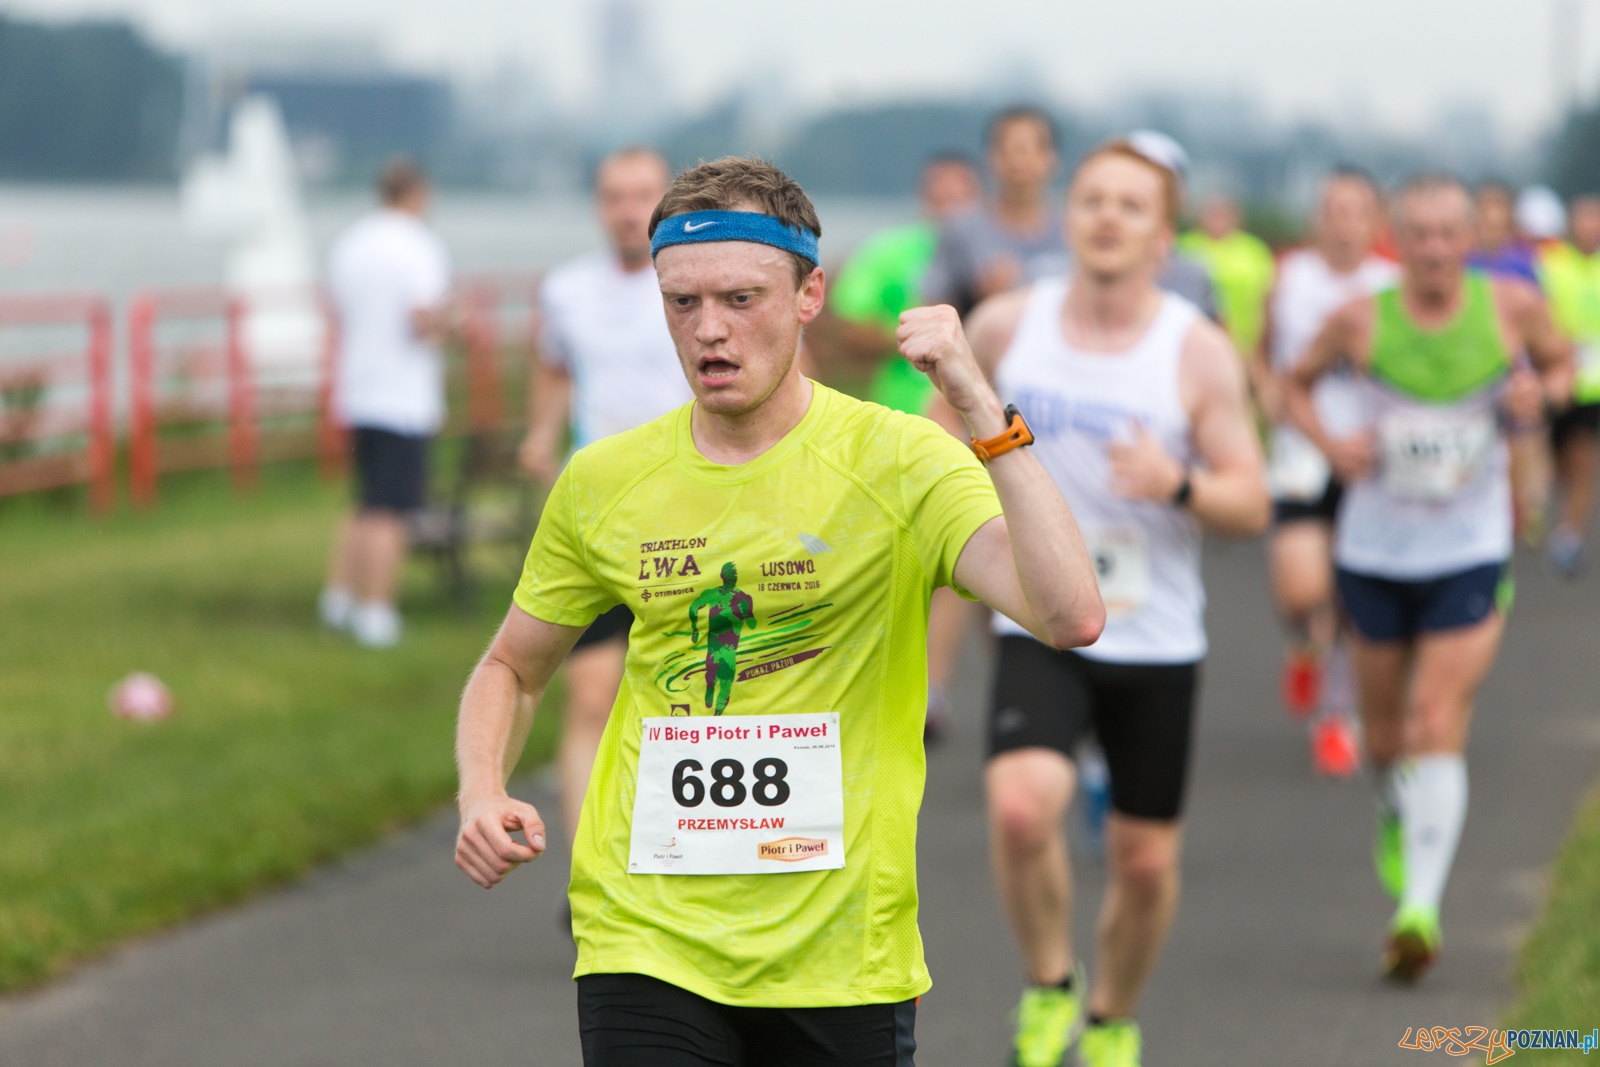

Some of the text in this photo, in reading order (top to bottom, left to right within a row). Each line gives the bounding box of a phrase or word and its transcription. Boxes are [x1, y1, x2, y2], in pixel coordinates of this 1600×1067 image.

[640, 538, 707, 553] TRIATHLON
[638, 554, 701, 580] LWA
[758, 581, 821, 592] 18 CZERWCA 2016
[745, 657, 795, 678] POKAZ PAZUR
[649, 722, 828, 744] IV Bieg Piotr i Paweł
[672, 757, 791, 808] 688
[677, 817, 785, 830] PRZEMYSŁAW
[761, 842, 824, 855] Piotr i Paweł
